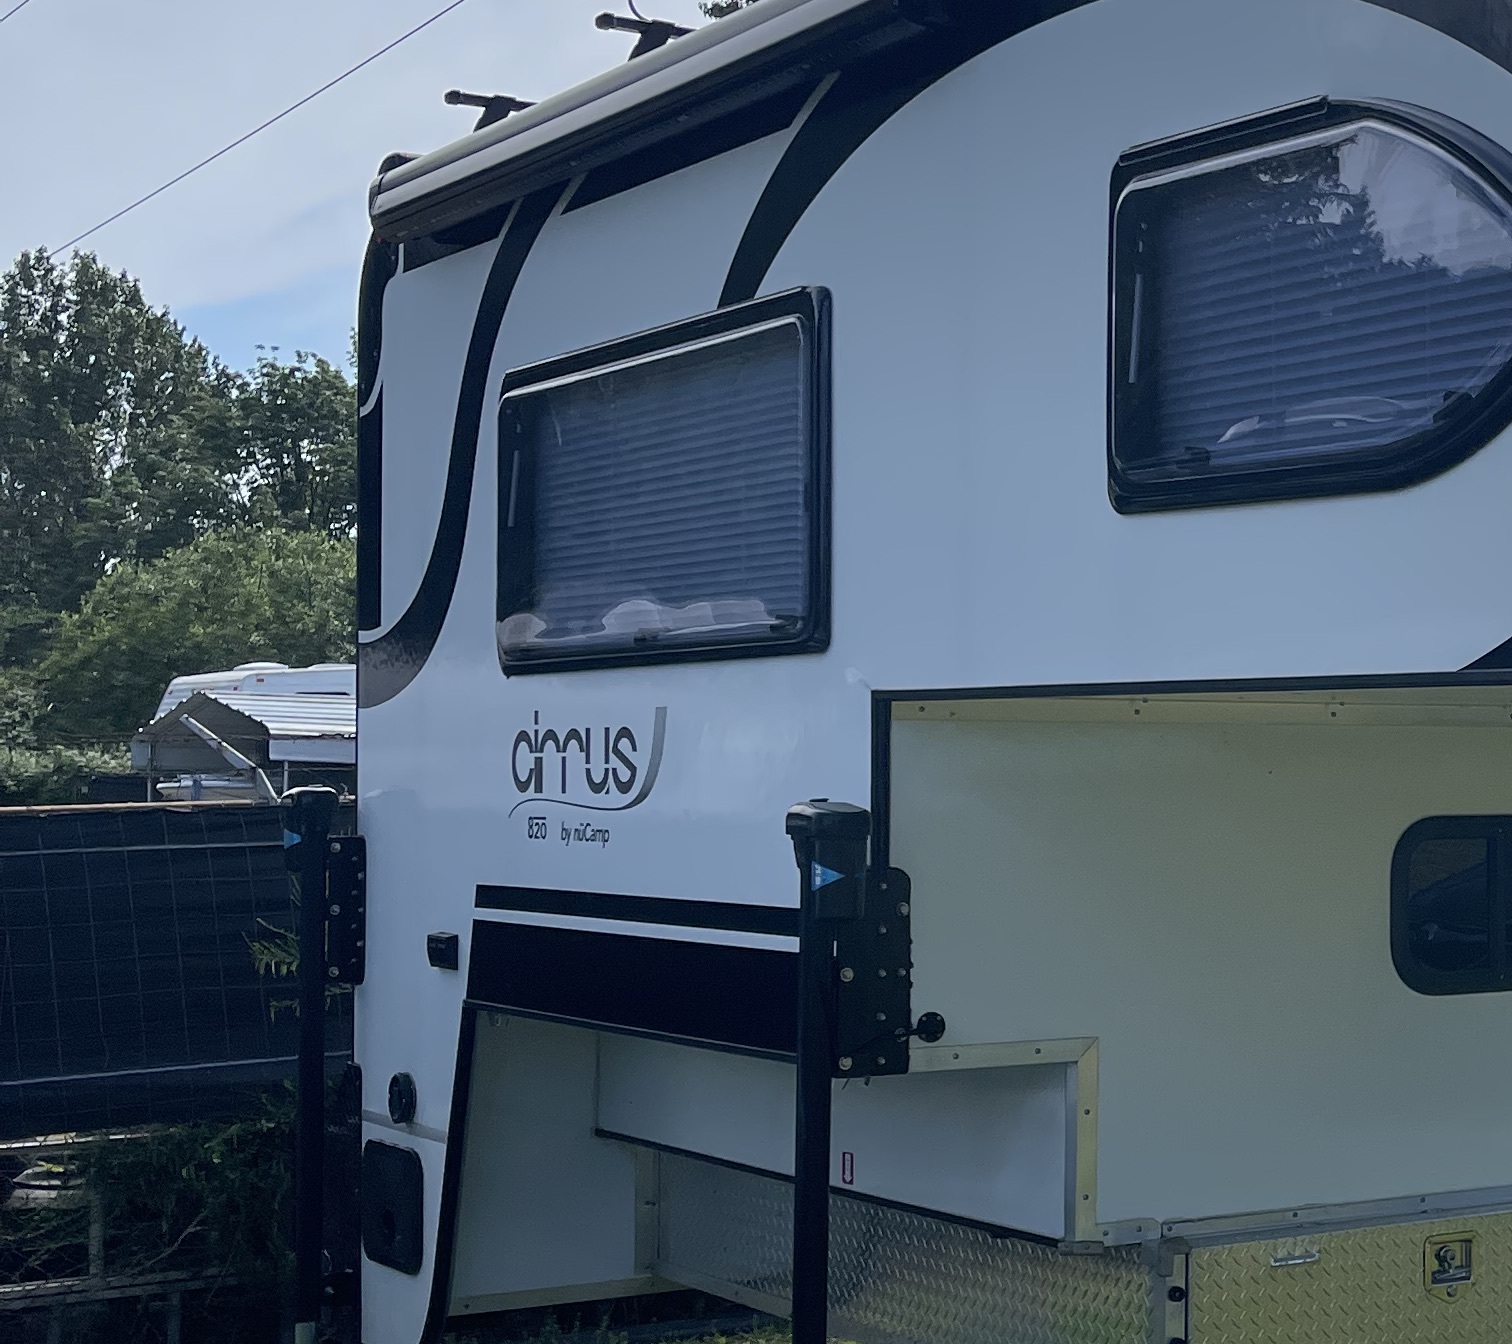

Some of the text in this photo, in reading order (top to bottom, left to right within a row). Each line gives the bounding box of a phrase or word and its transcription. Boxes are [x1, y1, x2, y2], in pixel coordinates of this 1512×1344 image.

[511, 710, 638, 795] cirrus
[528, 817, 547, 840] 820
[561, 821, 572, 846] by
